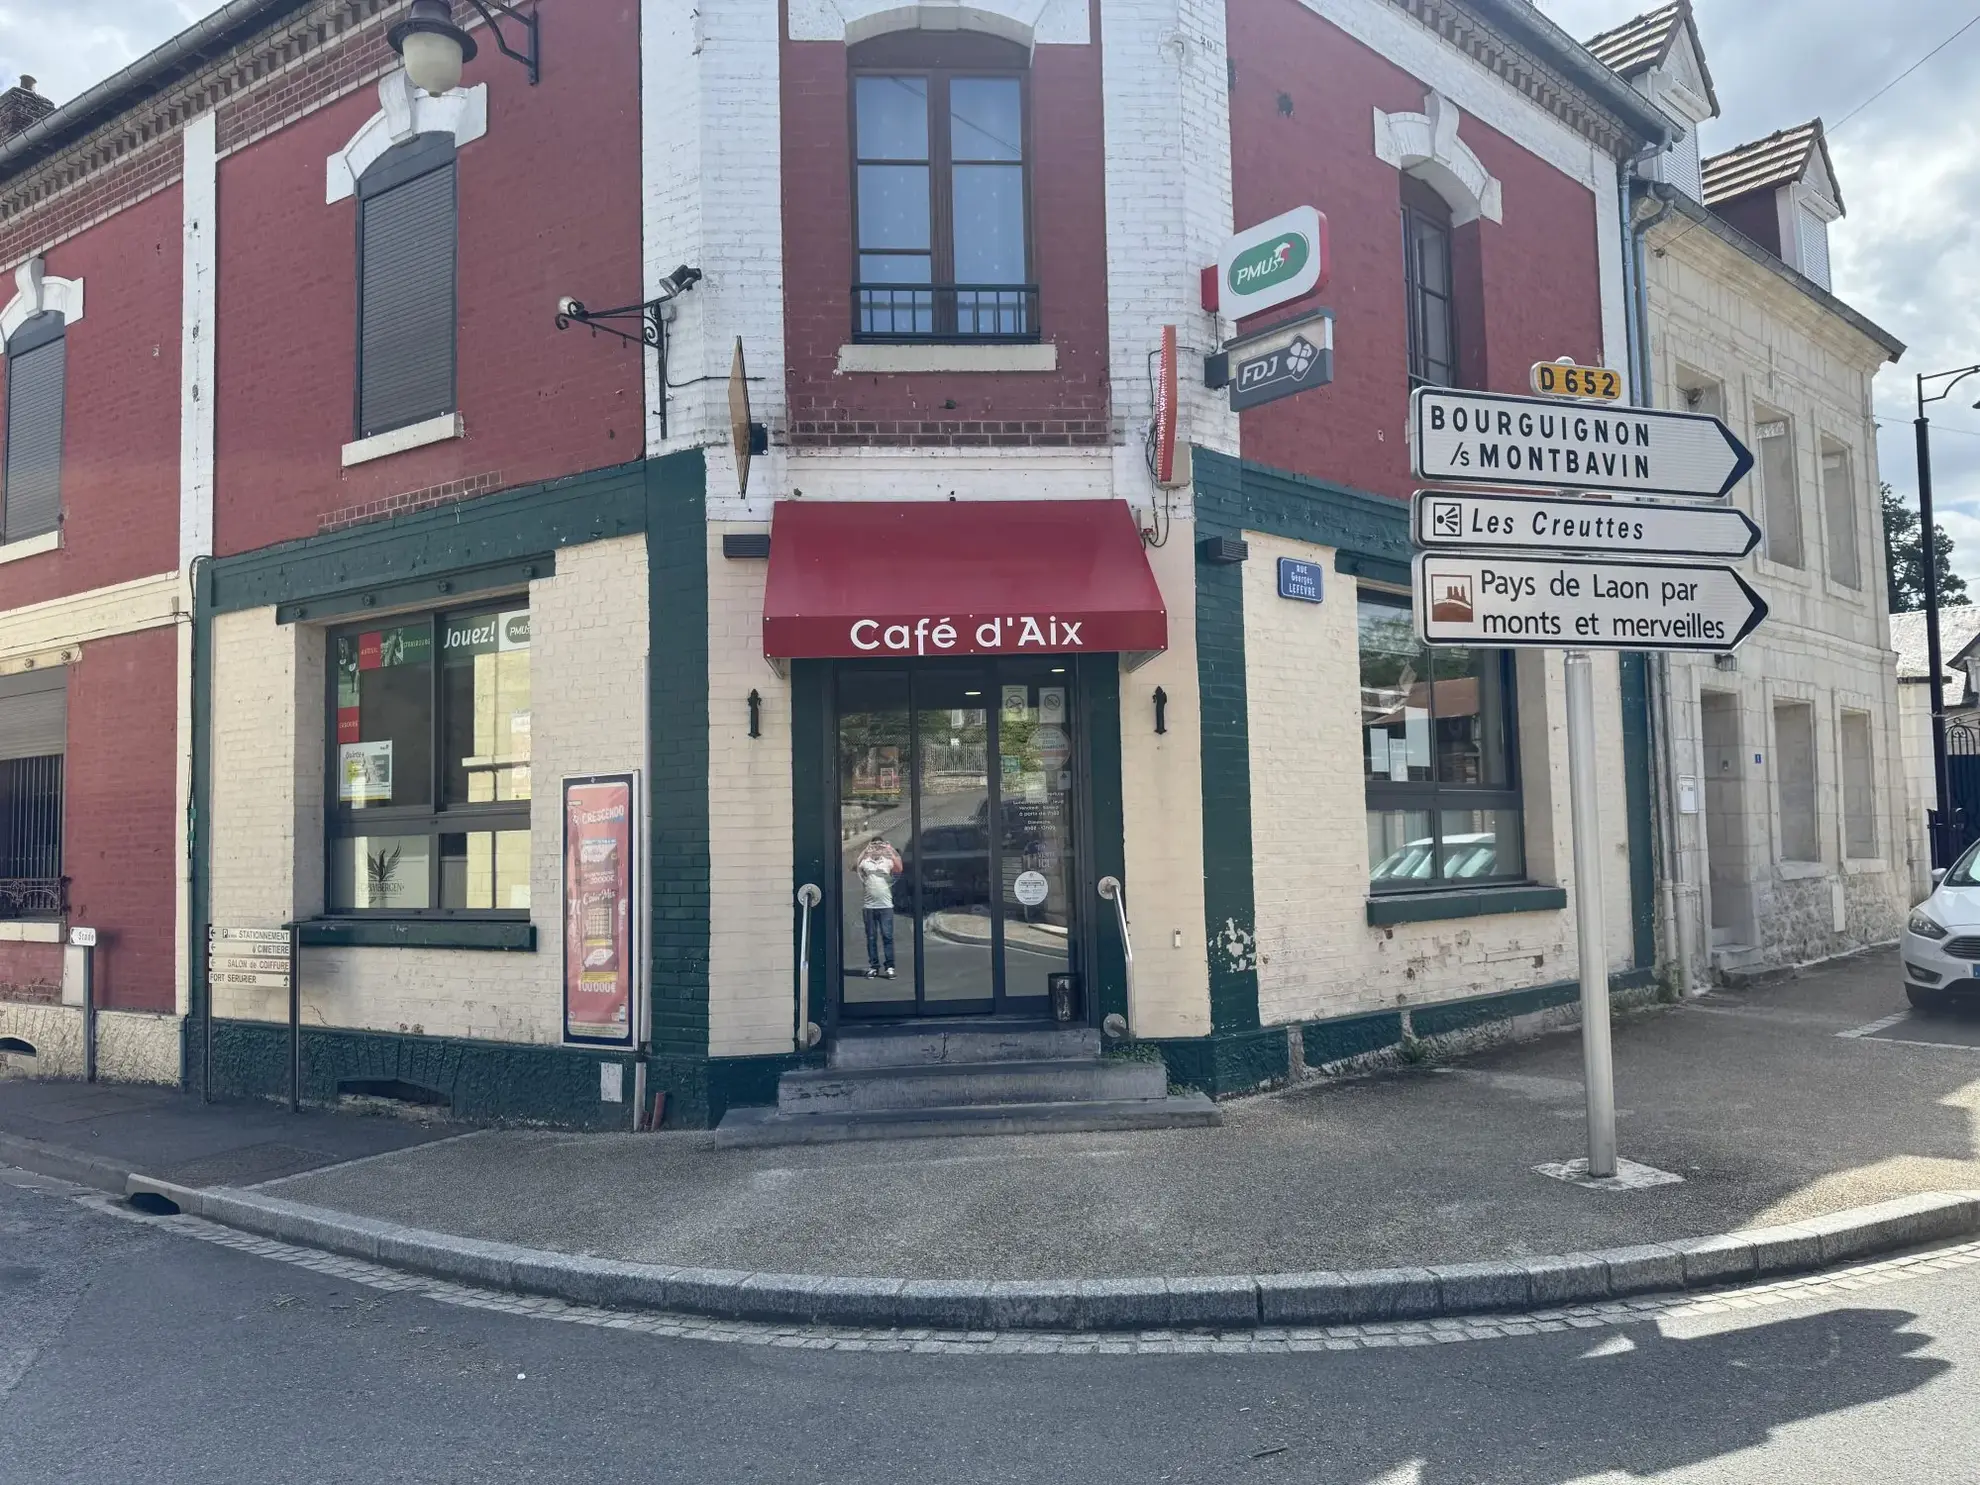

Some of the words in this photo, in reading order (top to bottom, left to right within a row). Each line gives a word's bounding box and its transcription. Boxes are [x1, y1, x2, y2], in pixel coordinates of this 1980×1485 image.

[1237, 257, 1273, 286] PMU
[1241, 356, 1279, 386] FDJ
[1539, 366, 1555, 390] D
[1565, 369, 1616, 397] 652
[1431, 404, 1649, 447] BOURGUIGNON
[1479, 442, 1649, 479] MONTBAVIN
[1471, 507, 1514, 535] Les
[1532, 510, 1644, 540] Creuttes
[1481, 569, 1536, 601] Pays
[1550, 569, 1580, 598] de
[1593, 573, 1649, 600] Laon
[1661, 580, 1698, 607] par
[443, 620, 495, 649] Jouez!
[850, 617, 958, 656] Café
[975, 615, 1084, 648] d'Aix
[1482, 611, 1562, 636] monts
[1575, 613, 1600, 636] et
[1613, 612, 1725, 640] merveilles
